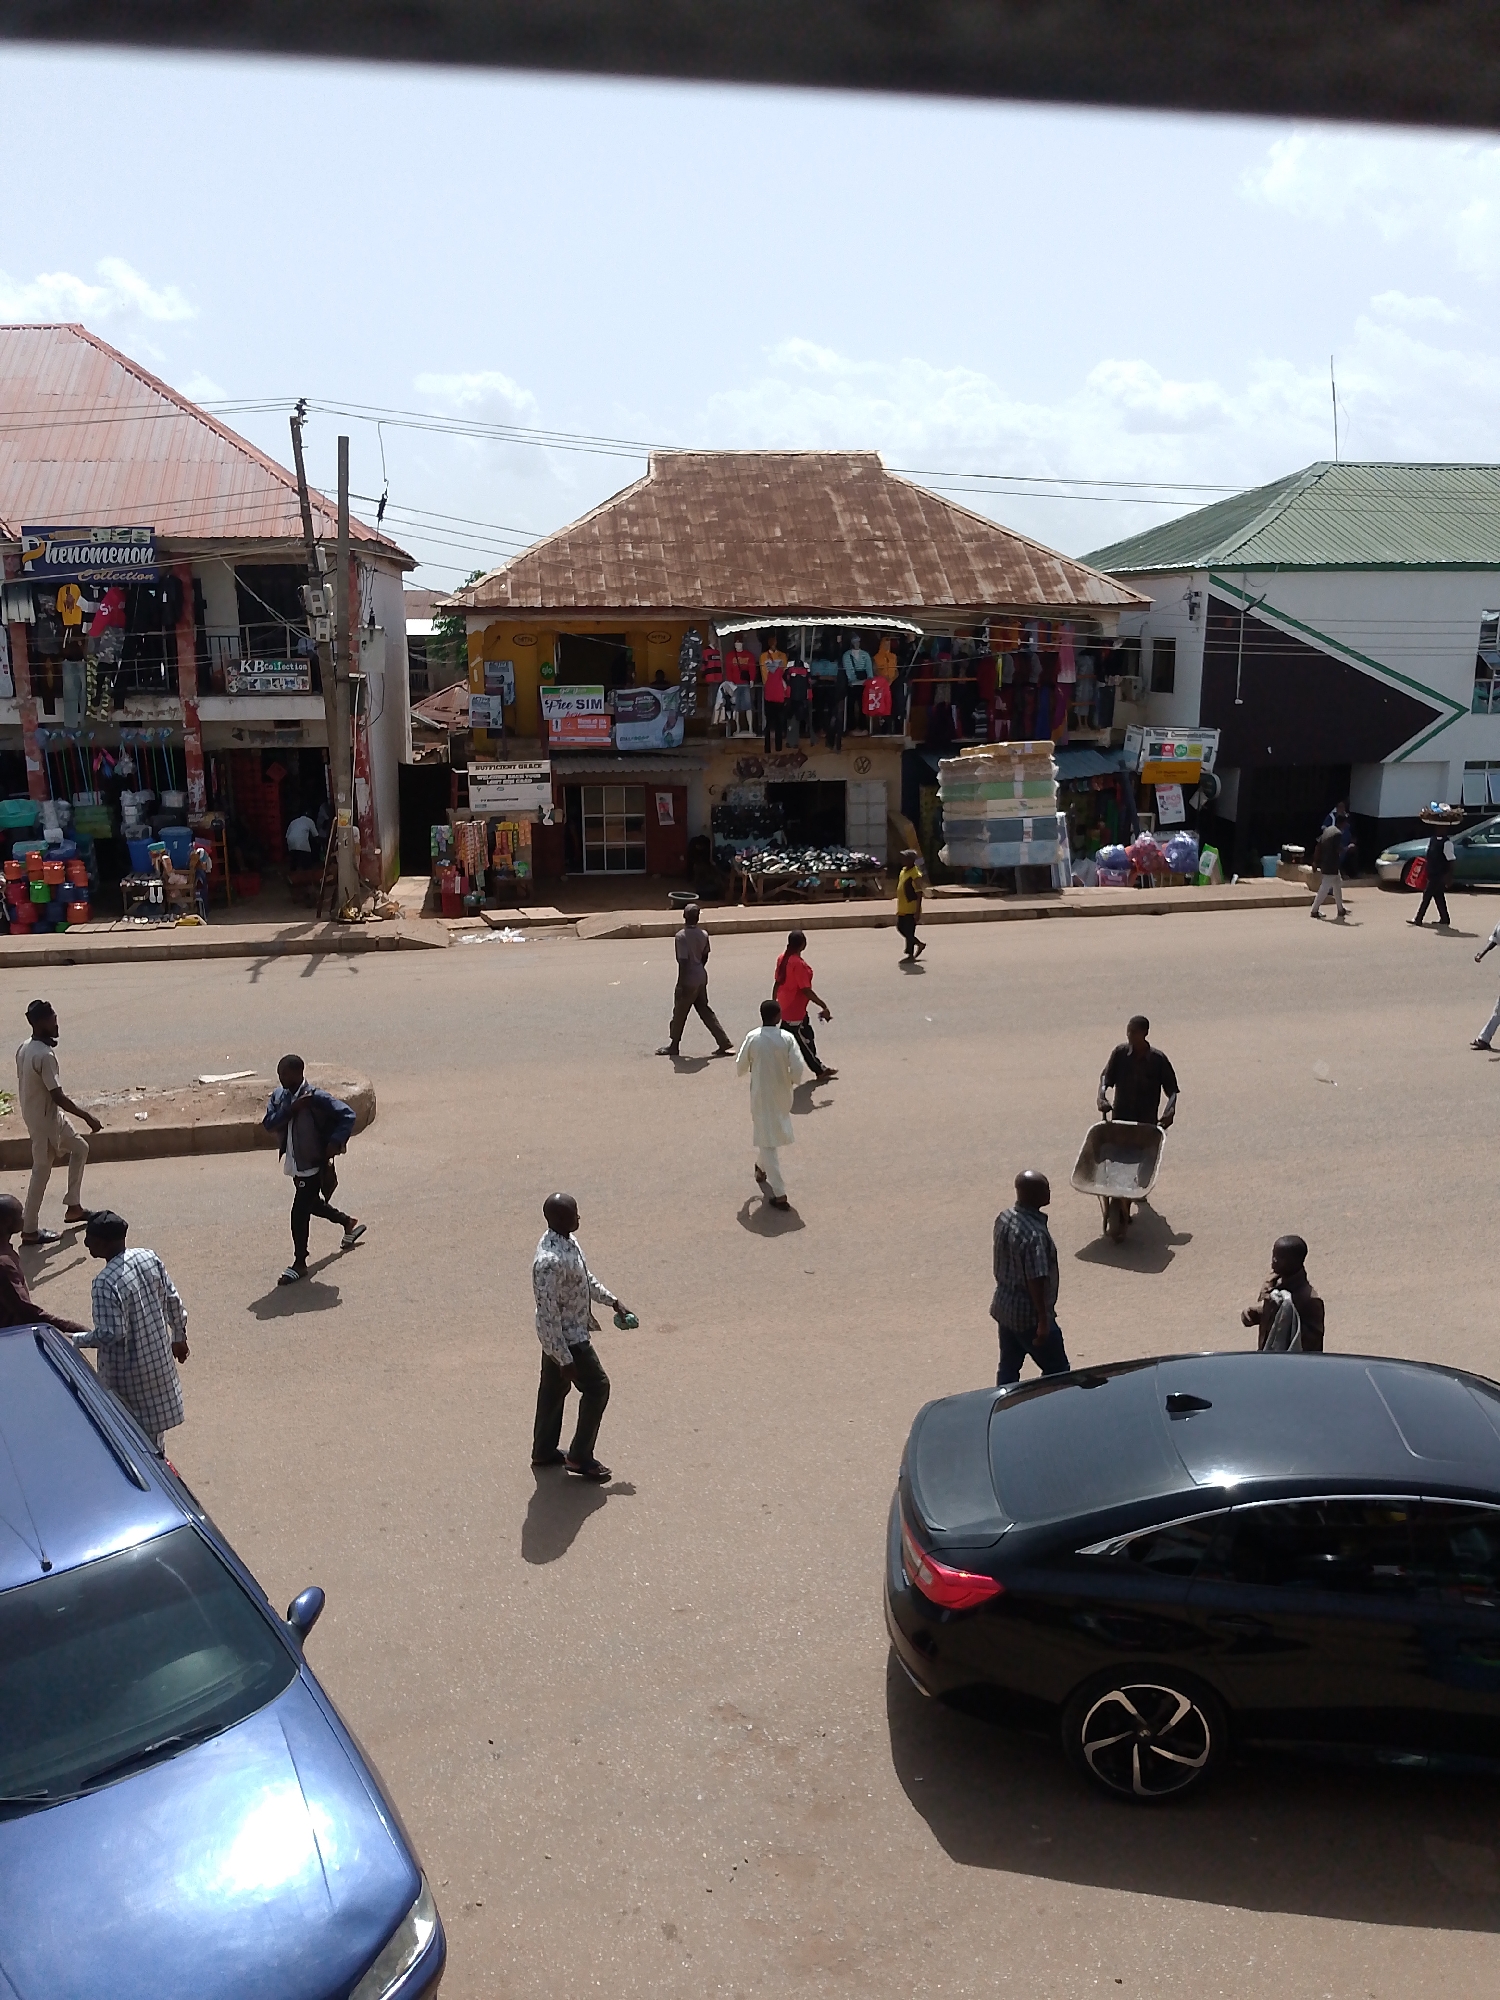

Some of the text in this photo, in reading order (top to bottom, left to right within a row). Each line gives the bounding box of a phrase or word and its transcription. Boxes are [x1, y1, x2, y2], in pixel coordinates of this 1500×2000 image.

[22, 536, 156, 572] Phenomenon
[78, 568, 155, 581] Collection
[264, 661, 308, 671] Collection
[545, 698, 573, 713] Free
[575, 698, 603, 711] SIM
